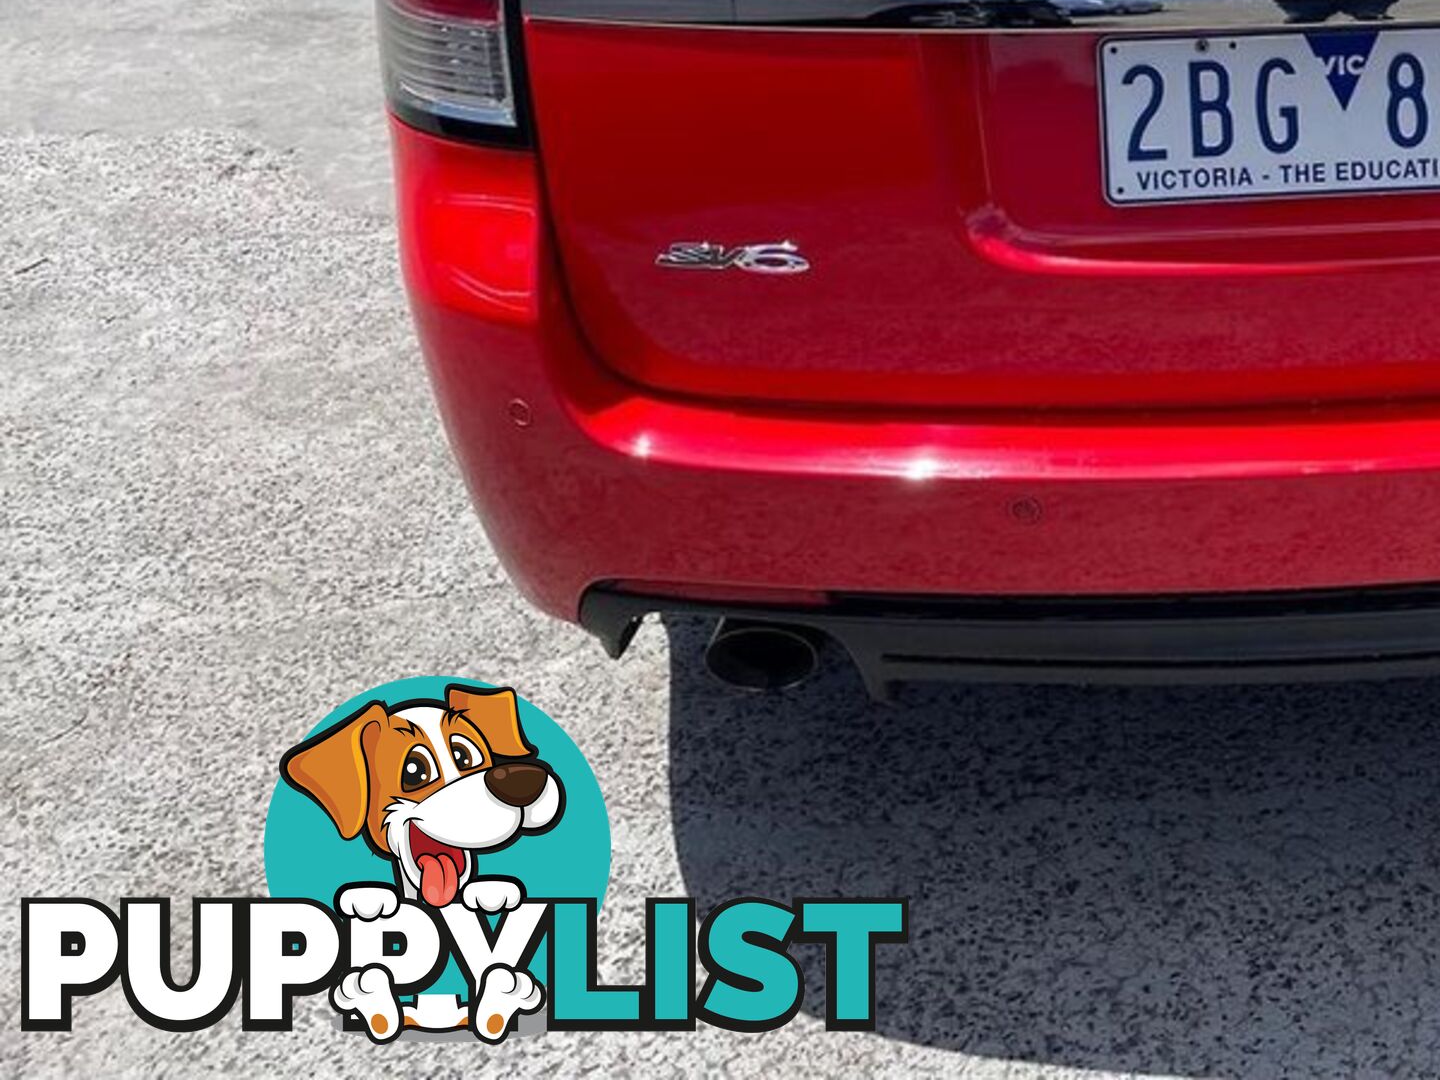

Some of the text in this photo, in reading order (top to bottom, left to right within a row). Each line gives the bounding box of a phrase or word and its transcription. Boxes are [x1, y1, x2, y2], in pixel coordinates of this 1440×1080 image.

[1320, 53, 1365, 77] VIC
[1121, 56, 1300, 163] 2BG
[1136, 167, 1253, 192] VICTORIA
[1279, 162, 1326, 183] THE
[655, 239, 811, 275] SV6
